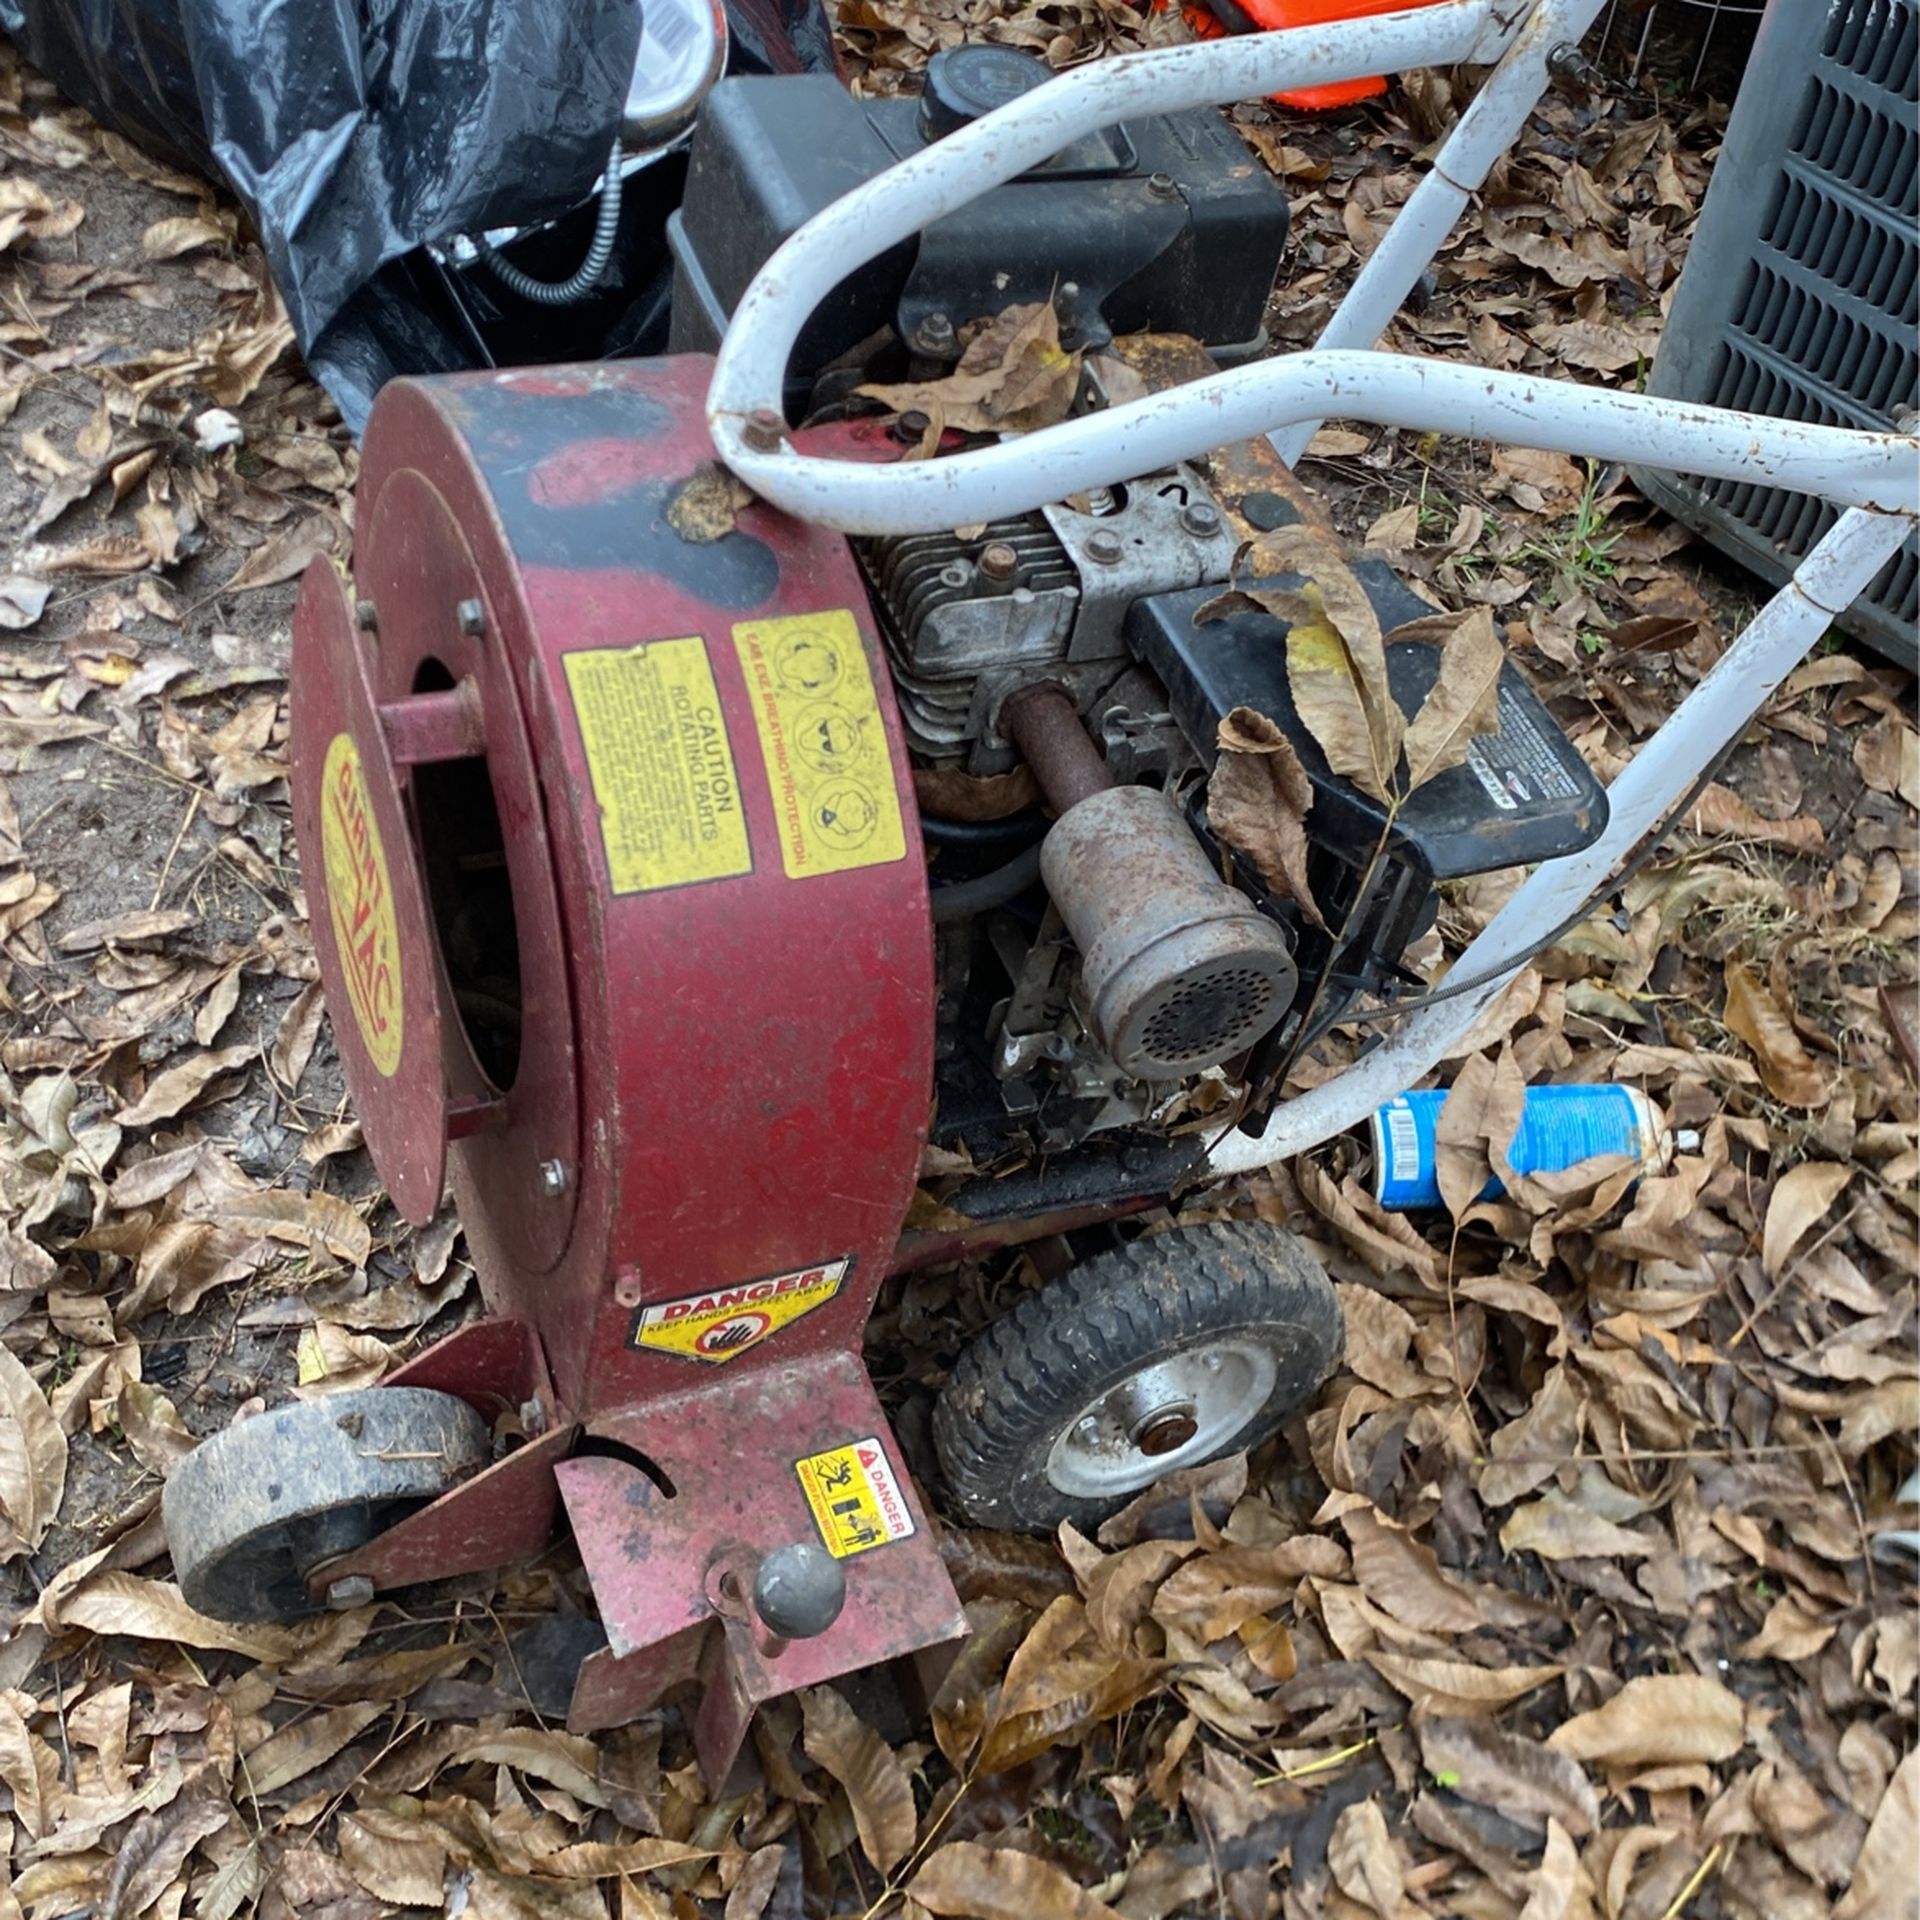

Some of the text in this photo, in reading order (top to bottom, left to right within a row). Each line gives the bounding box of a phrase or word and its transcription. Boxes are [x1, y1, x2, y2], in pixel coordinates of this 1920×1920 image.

[670, 684, 719, 842] ROTATING PARTS
[696, 706, 733, 814] CAUTION
[762, 693, 792, 773] BREATHING
[780, 773, 808, 866] PROTECTION
[646, 1319, 684, 1334] KEEP
[685, 1308, 732, 1325] HANDS
[756, 1293, 790, 1308] FEET
[793, 1283, 830, 1299] AWAY
[663, 1269, 826, 1320] DANGER
[870, 1470, 905, 1535] DANGER
